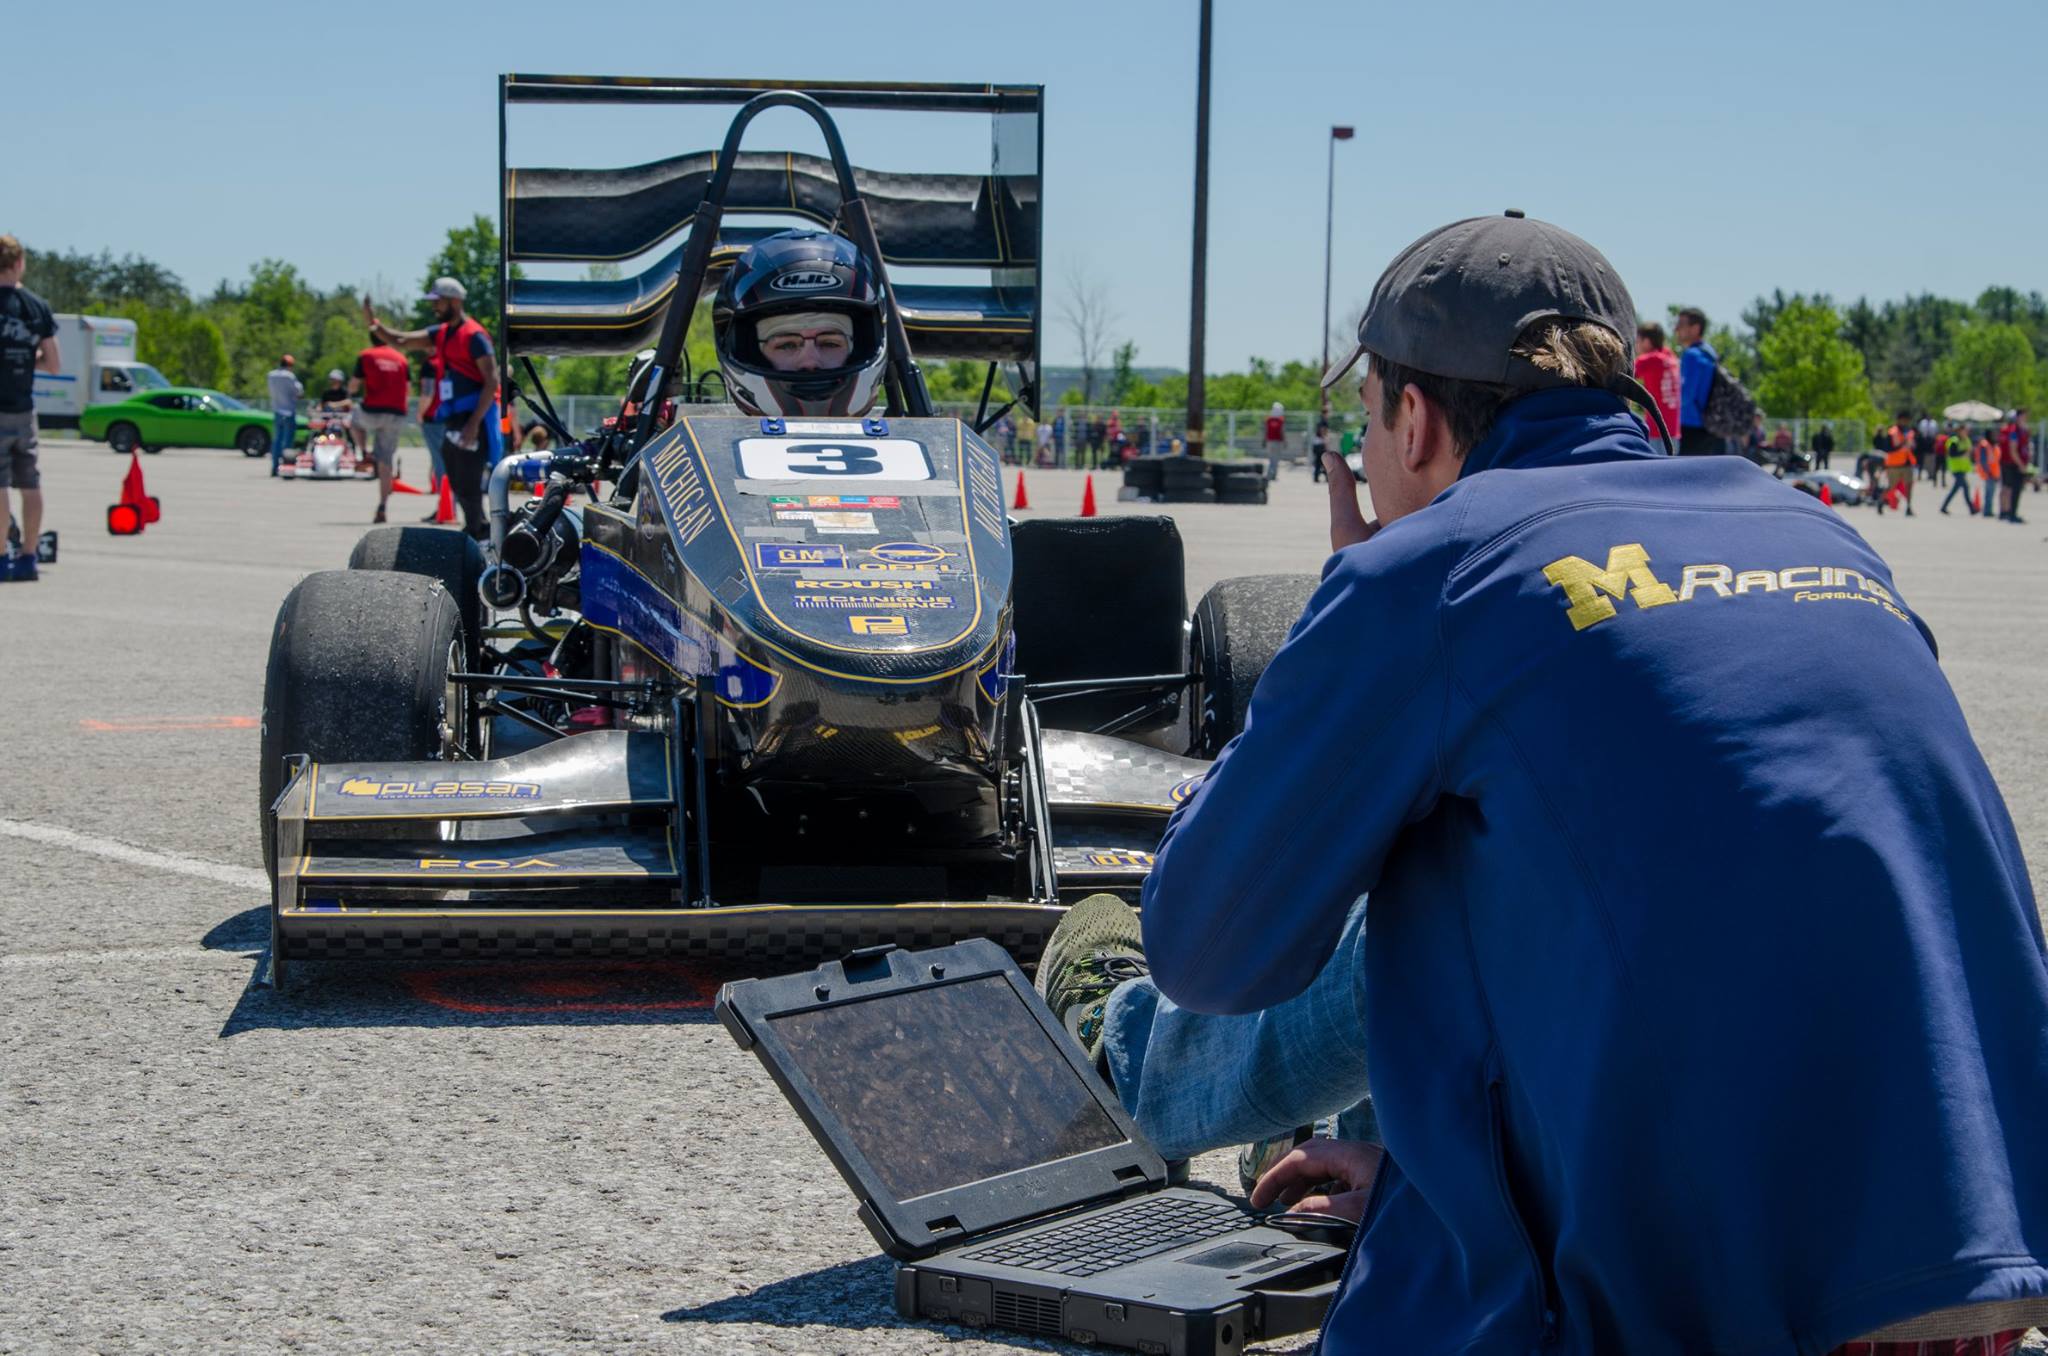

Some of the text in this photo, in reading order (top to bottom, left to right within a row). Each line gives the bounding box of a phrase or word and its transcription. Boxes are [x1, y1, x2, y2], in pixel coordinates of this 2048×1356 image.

[783, 274, 832, 286] HJC
[786, 444, 883, 475] 3
[652, 434, 715, 546] MICHIGAN
[966, 434, 1005, 548] MICHIGAN
[778, 549, 824, 562] GM
[858, 563, 951, 573] OPEL
[795, 580, 933, 590] ROUSH
[1542, 543, 1678, 631] M
[795, 595, 953, 603] TECHNIQUE
[420, 859, 561, 870] FCA
